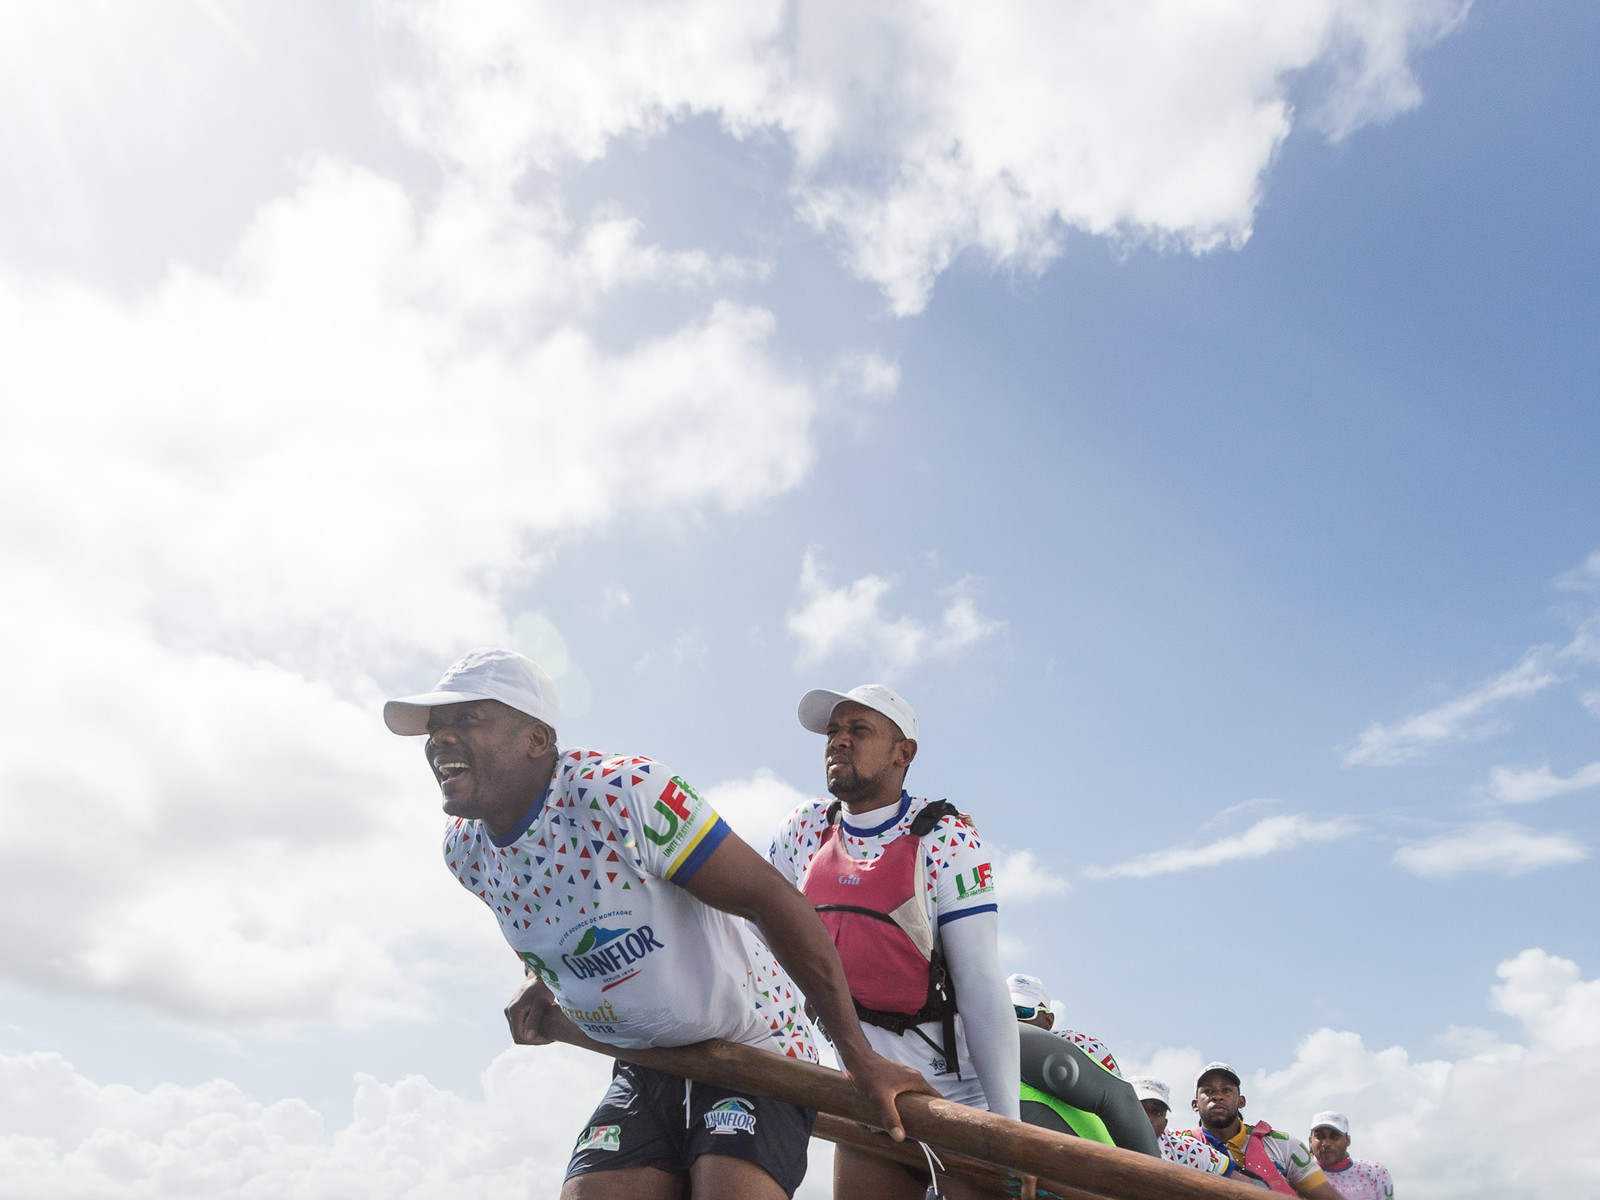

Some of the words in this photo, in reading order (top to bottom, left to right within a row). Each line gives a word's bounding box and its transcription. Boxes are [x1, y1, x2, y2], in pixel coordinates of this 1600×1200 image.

[838, 874, 860, 885] Gill
[599, 910, 632, 920] MONTAGNE
[561, 925, 664, 980] CHANFLOR
[584, 1024, 616, 1034] 2018
